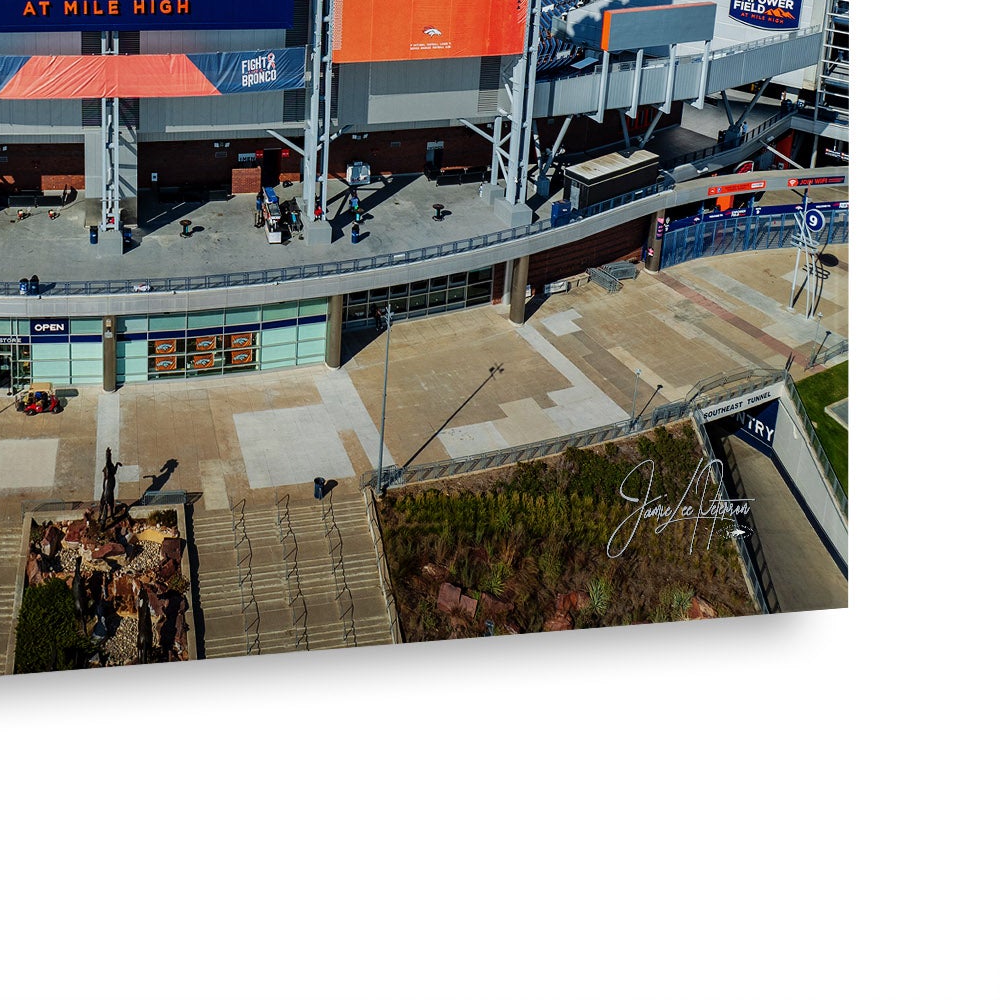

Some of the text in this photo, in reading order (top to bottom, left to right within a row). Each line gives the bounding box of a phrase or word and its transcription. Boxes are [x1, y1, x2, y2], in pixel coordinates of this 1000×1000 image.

[23, 0, 189, 16] AT MILE HIGH
[733, 0, 766, 14] FIELD
[241, 56, 266, 74] FIGHT
[242, 69, 277, 87] BRONCO
[809, 215, 818, 227] 9
[34, 323, 65, 332] OPEN
[703, 391, 771, 419] SOUTHEAST TUNNEL
